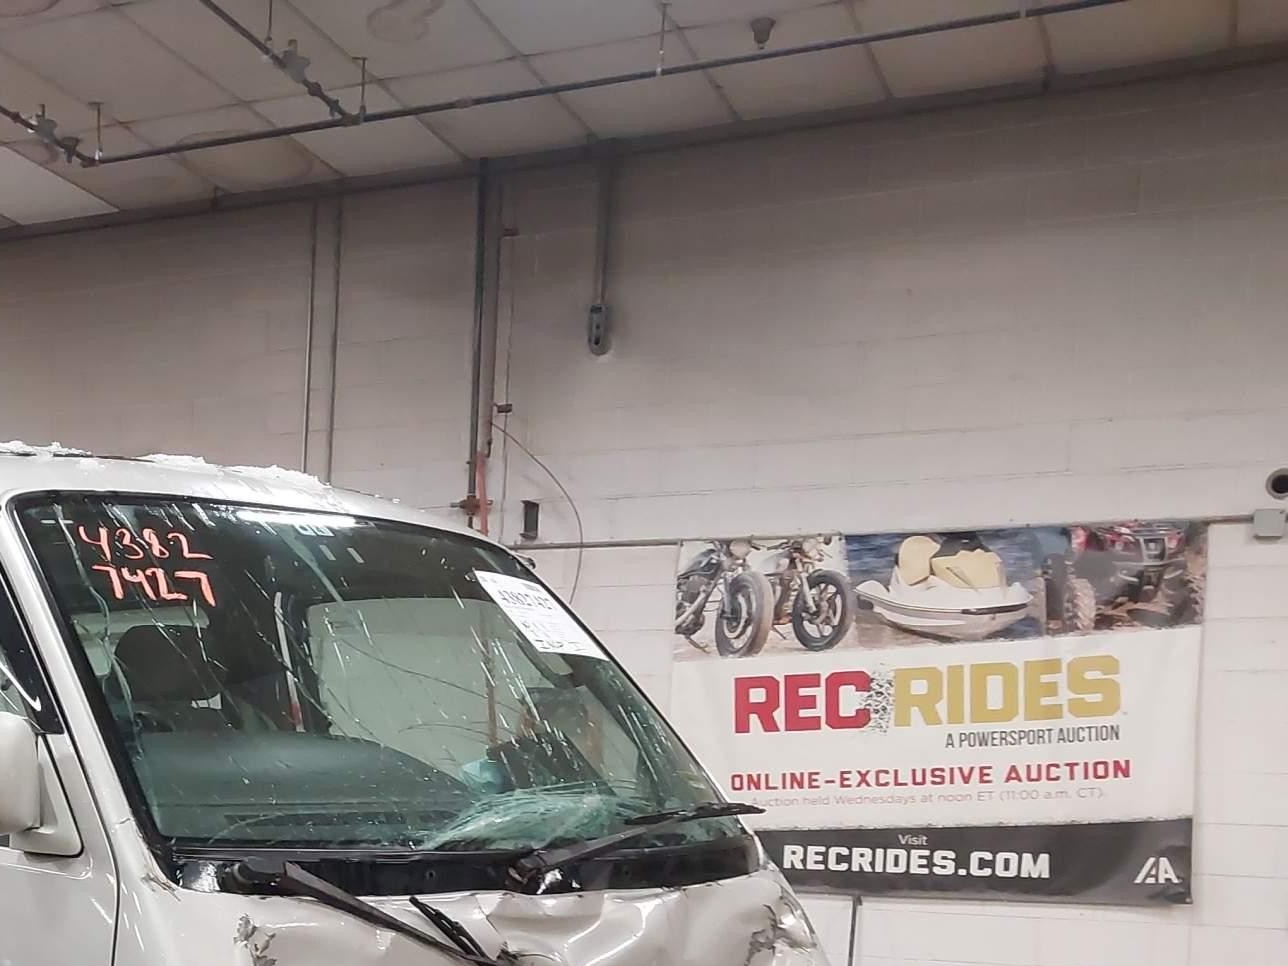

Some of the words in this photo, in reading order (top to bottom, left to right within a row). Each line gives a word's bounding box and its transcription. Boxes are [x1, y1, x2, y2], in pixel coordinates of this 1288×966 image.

[78, 526, 214, 560] 4382
[91, 564, 217, 608] 7427
[734, 670, 872, 733] REC
[893, 654, 1121, 727] RIDES
[945, 732, 955, 749] A
[958, 728, 1054, 748] POWERSPORT
[1057, 724, 1120, 744] AUCTION
[731, 765, 993, 791] ONLINE-EXCLUSIVE
[1004, 759, 1131, 784] AUCTION
[752, 796, 799, 808] Auction
[802, 795, 830, 806] held
[834, 793, 915, 807] Wednesdays
[920, 792, 934, 803] at
[937, 792, 972, 803] noon
[977, 790, 995, 802] ET
[999, 789, 1040, 802] (11:00
[897, 833, 929, 846] Visit
[783, 844, 1051, 879] RECRIDES.COM
